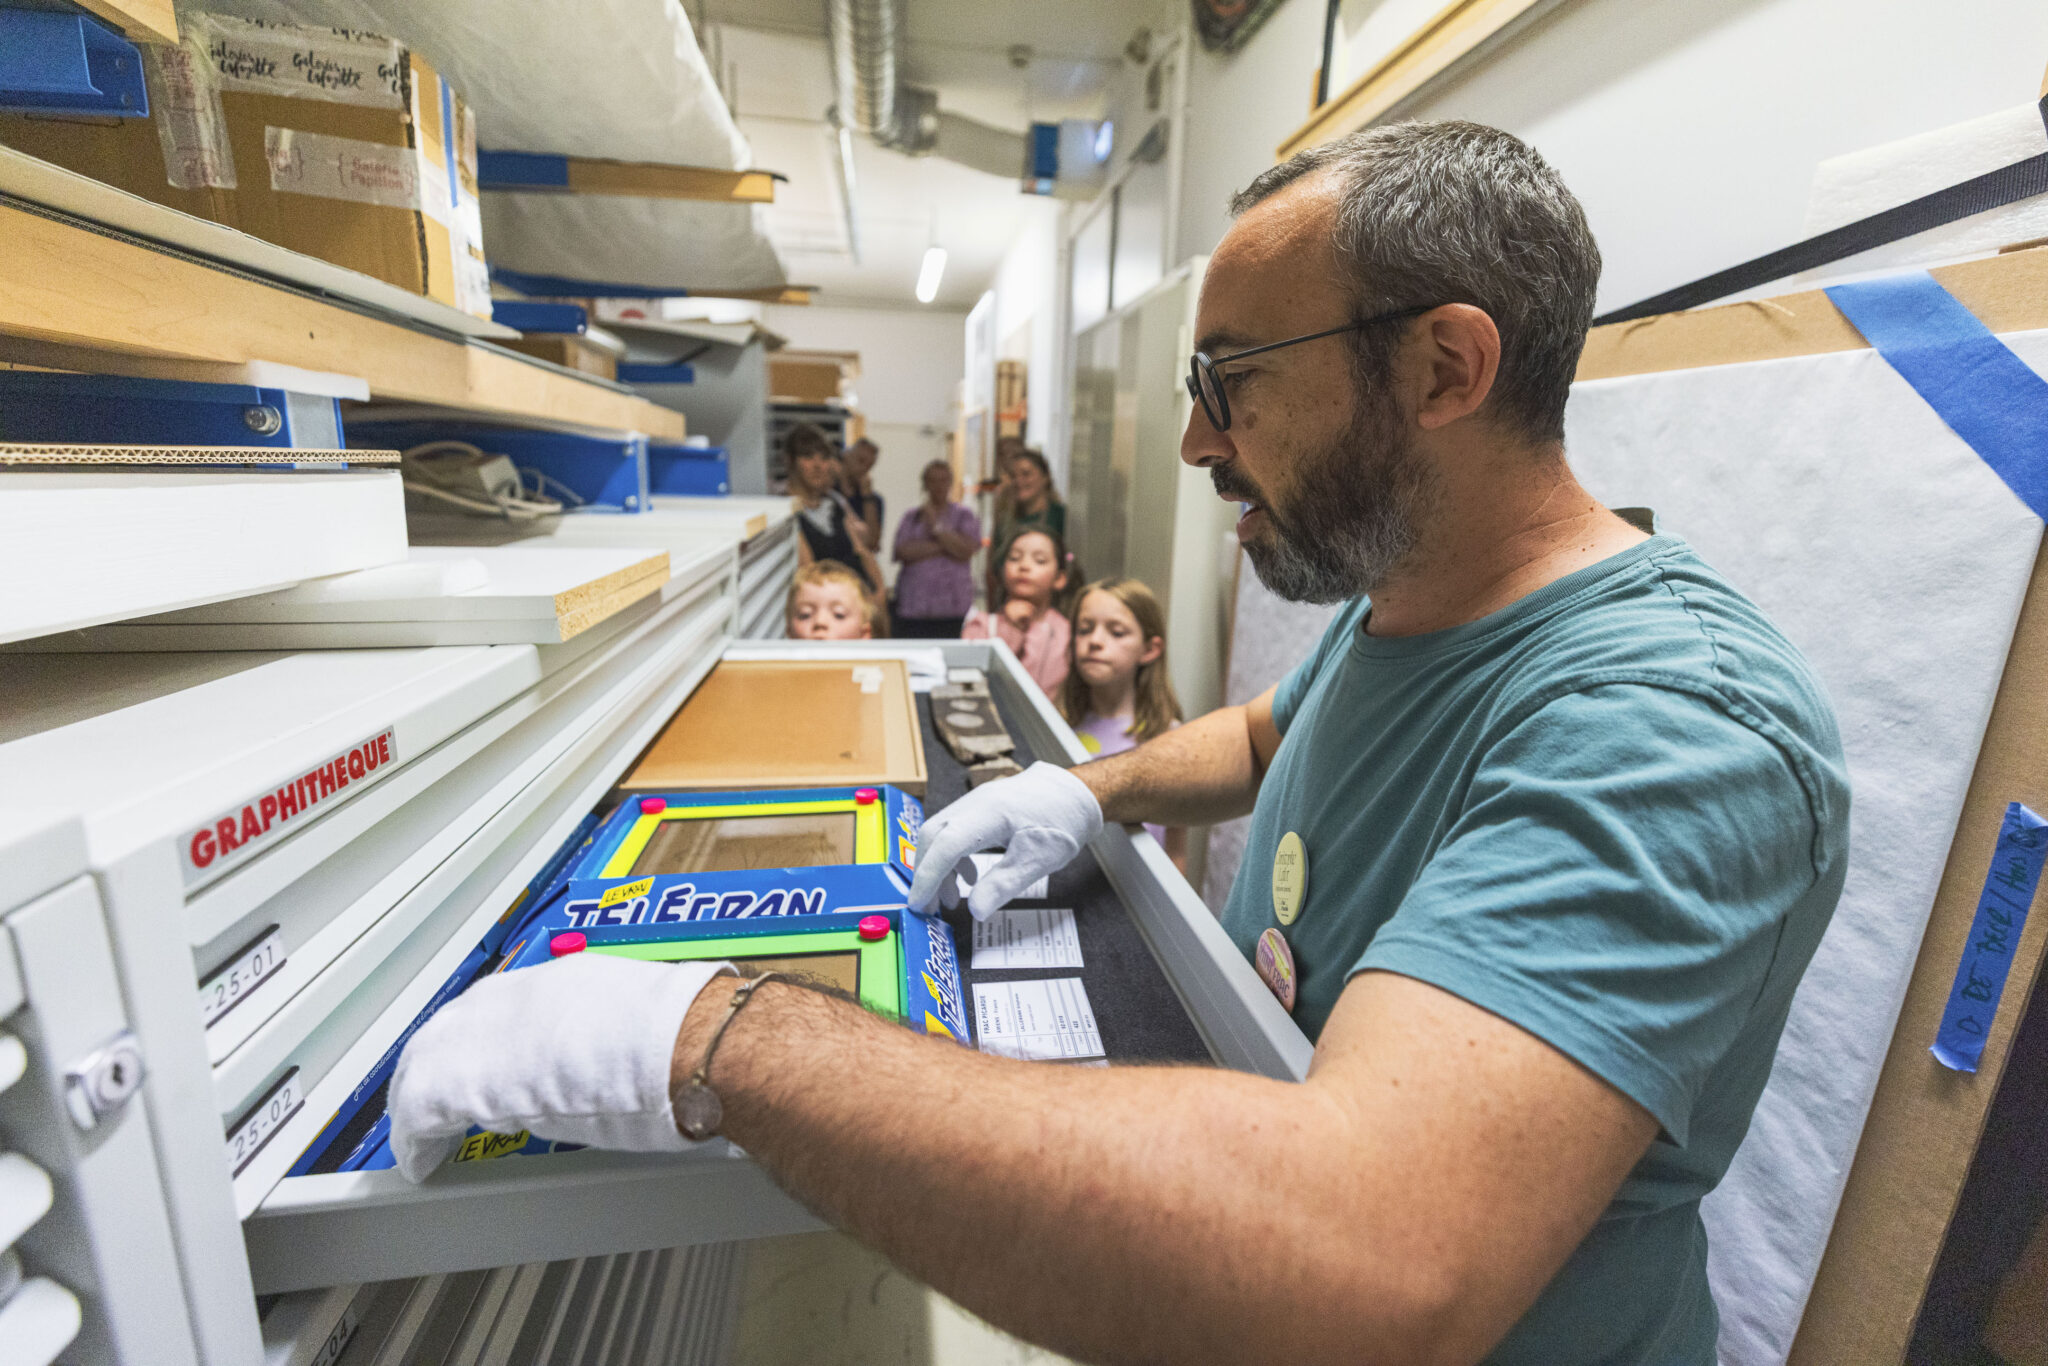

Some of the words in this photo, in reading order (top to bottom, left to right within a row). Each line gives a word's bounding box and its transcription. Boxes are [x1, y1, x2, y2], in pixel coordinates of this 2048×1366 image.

[190, 733, 391, 868] GRAPHITHEQUE
[979, 995, 988, 1019] PICARDIE
[982, 1018, 990, 1034] FRAC
